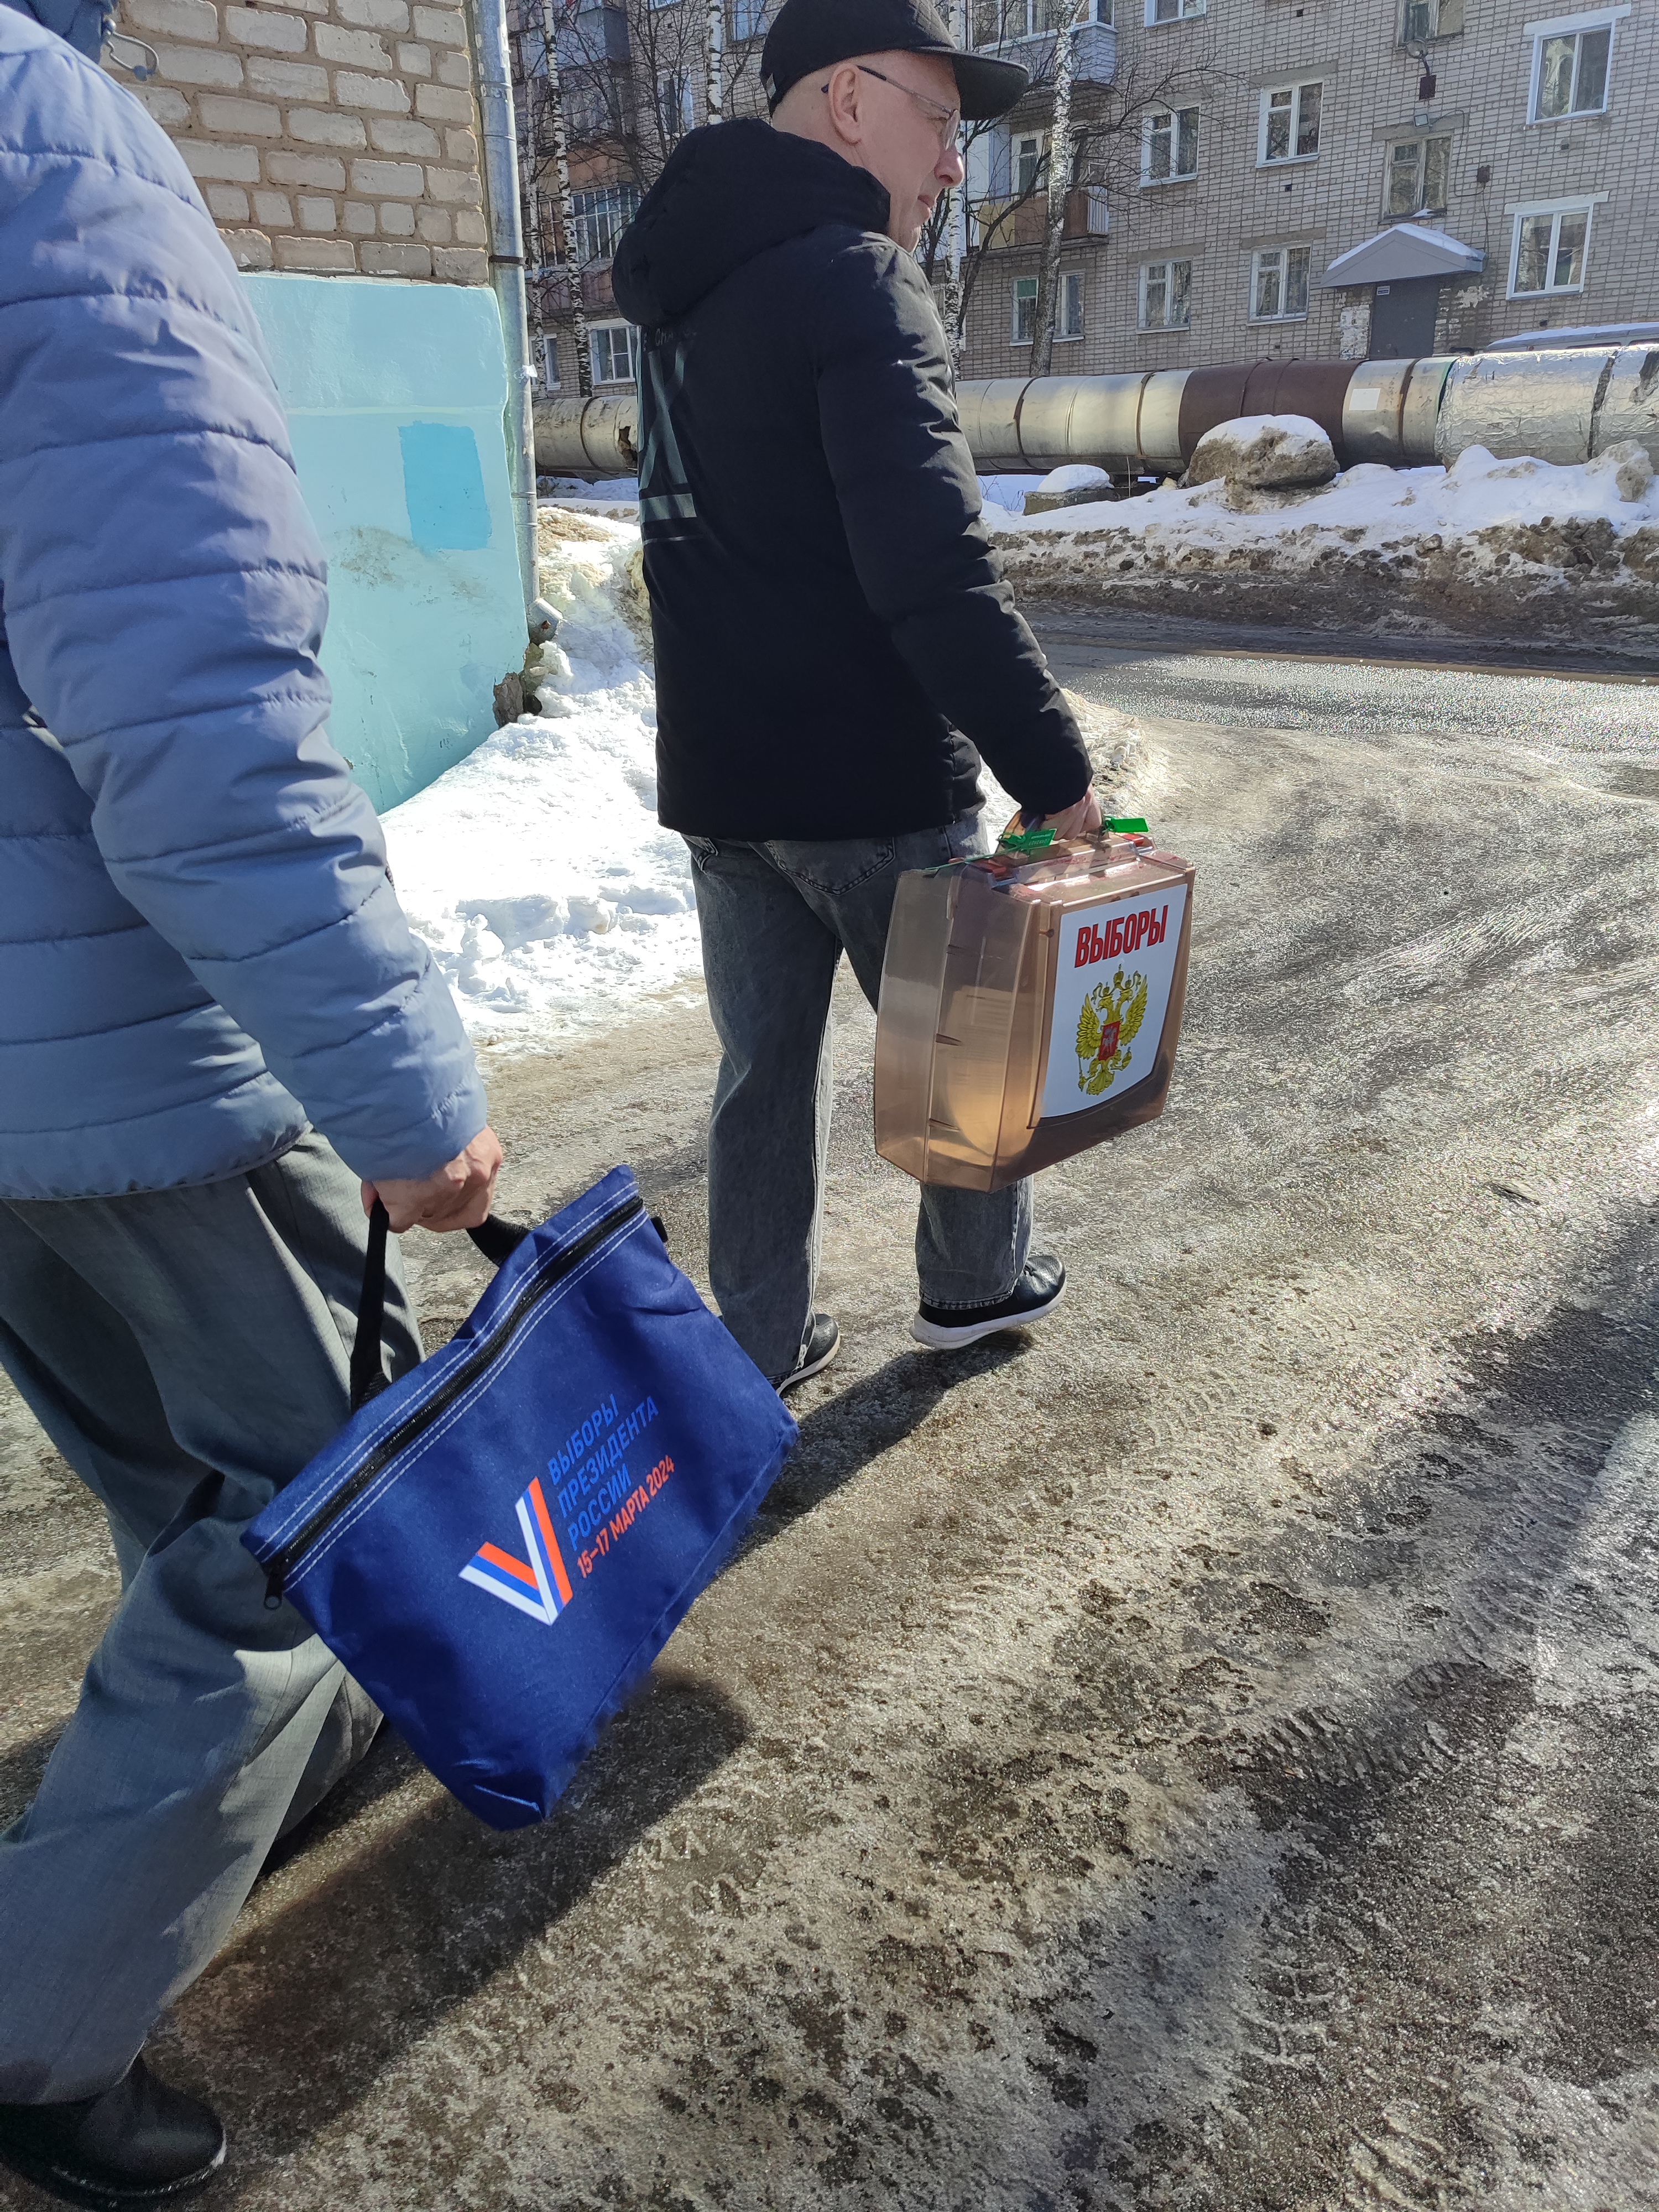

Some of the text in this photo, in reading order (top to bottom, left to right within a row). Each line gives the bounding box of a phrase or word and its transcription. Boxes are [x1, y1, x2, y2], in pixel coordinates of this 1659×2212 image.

[1074, 905, 1168, 968] ВЫБОРЫ
[547, 1394, 619, 1485] ВЫБОРЫ
[557, 1395, 659, 1517] ПРЕЗИДЕНТА
[568, 1463, 632, 1551] РОССИИ
[609, 1485, 650, 1542] МАРТА
[646, 1455, 675, 1497] 2024
